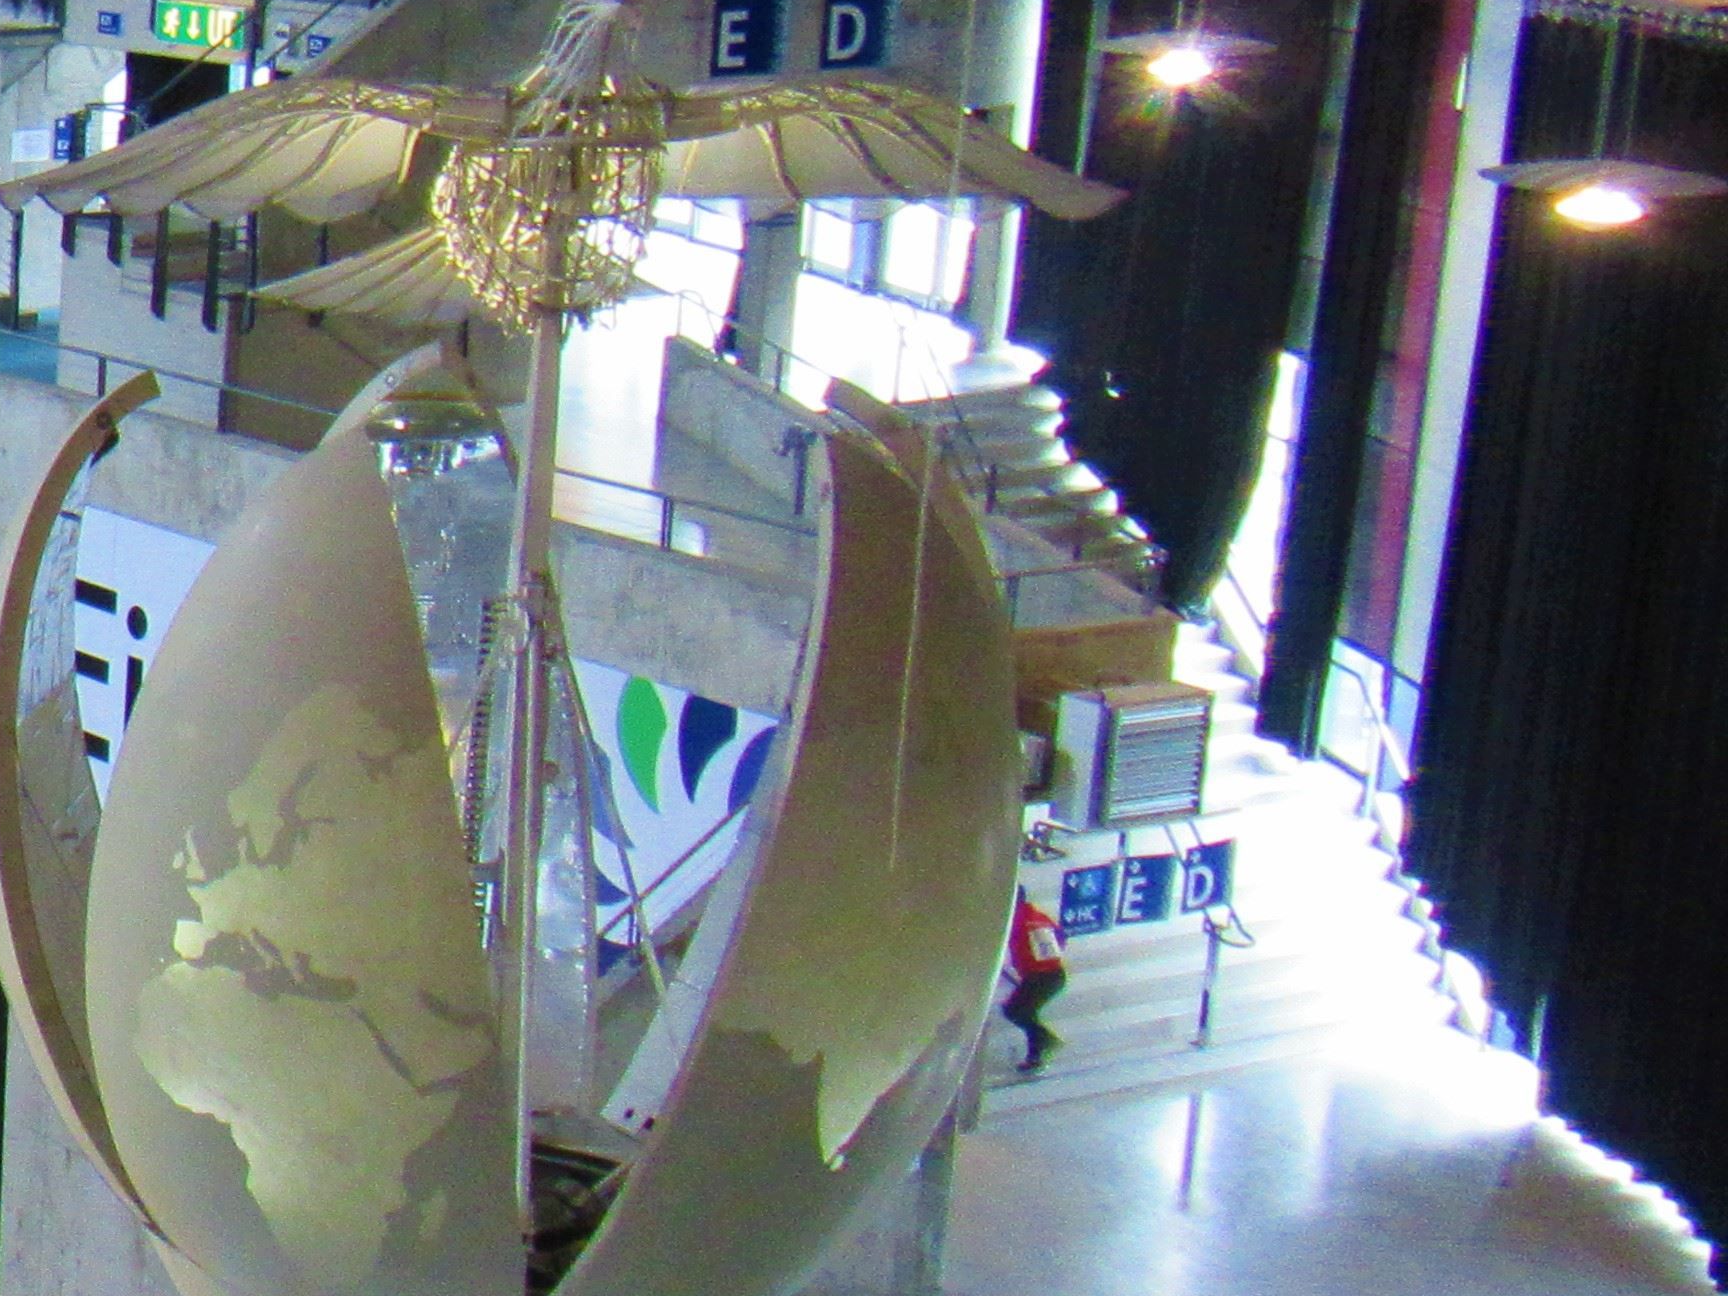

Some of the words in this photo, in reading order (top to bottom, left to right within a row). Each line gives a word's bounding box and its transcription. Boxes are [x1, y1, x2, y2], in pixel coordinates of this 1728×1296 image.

[718, 10, 750, 69] E
[826, 5, 868, 61] D
[1121, 875, 1148, 920] E
[1186, 864, 1215, 908] D
